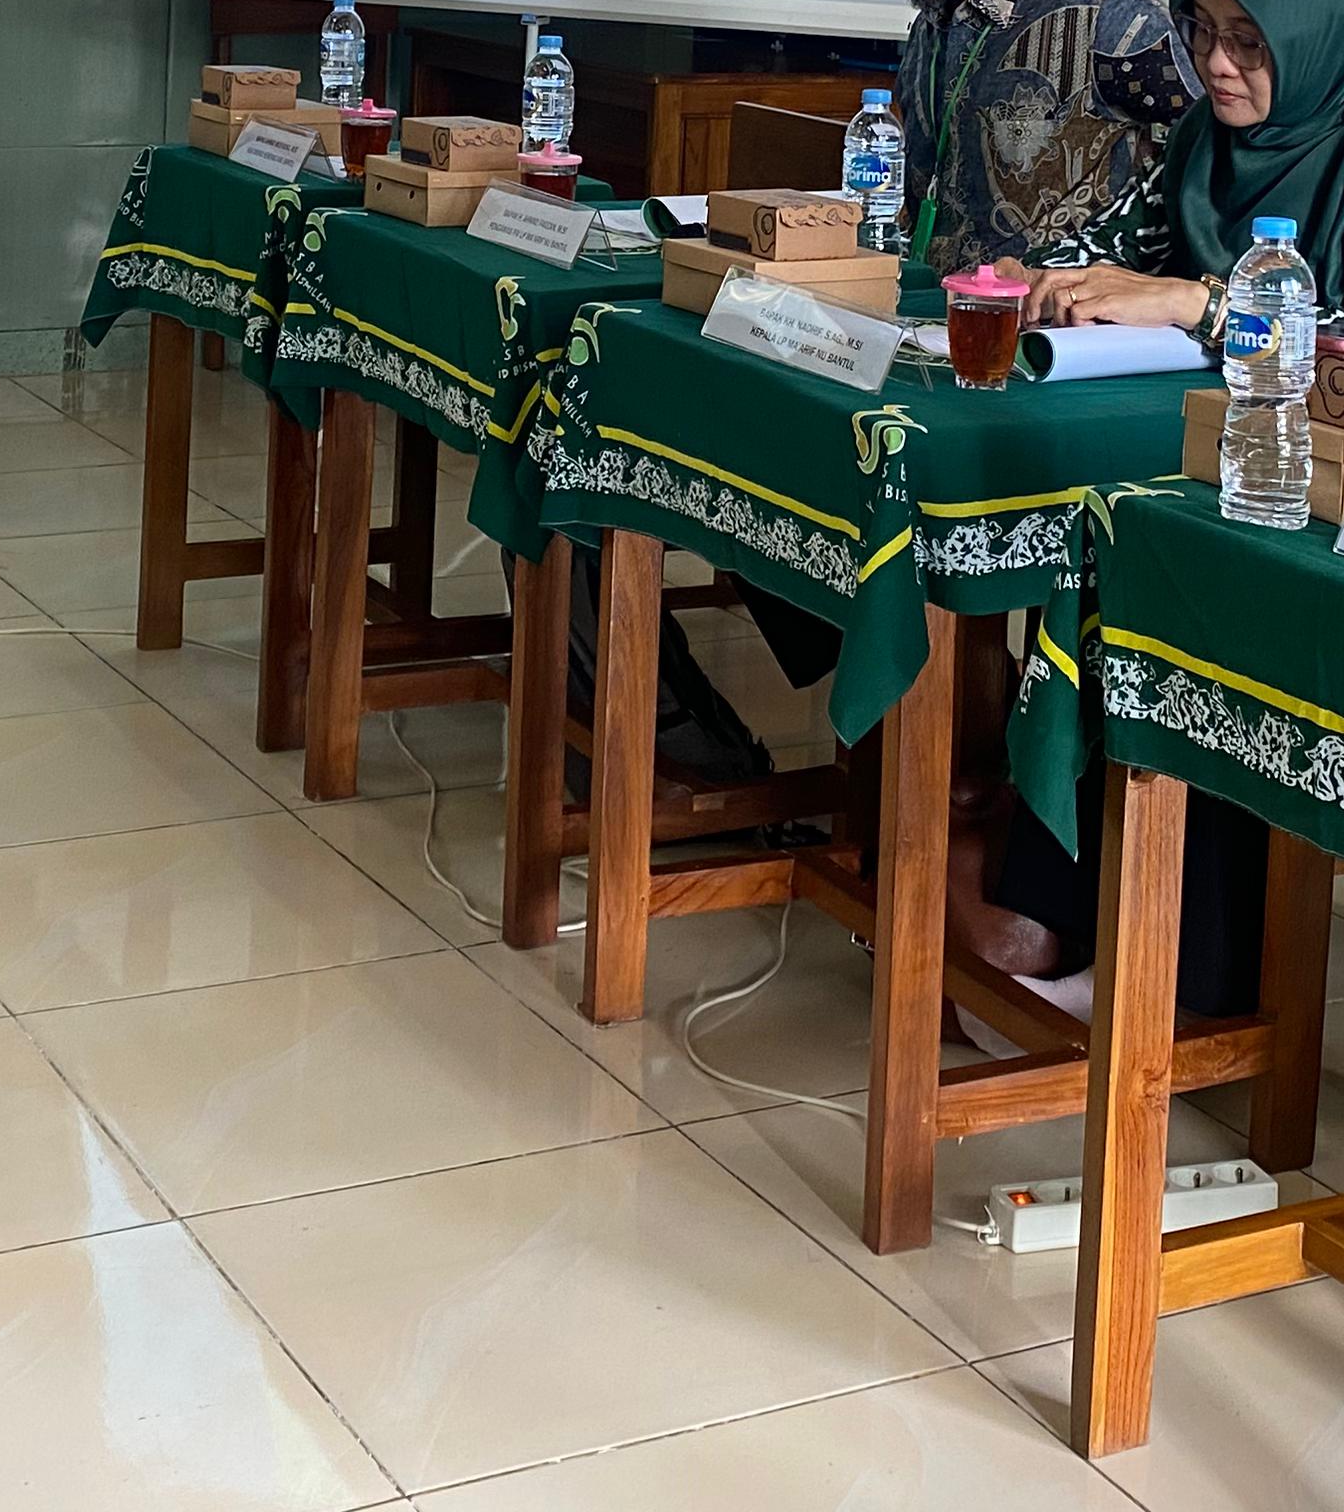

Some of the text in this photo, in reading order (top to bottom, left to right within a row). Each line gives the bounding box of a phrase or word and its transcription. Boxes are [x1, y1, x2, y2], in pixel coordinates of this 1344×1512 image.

[848, 167, 891, 183] prima
[749, 325, 776, 344] KEPALA
[776, 335, 788, 346] LP
[816, 349, 827, 360] NU
[826, 353, 855, 371] BANTUL
